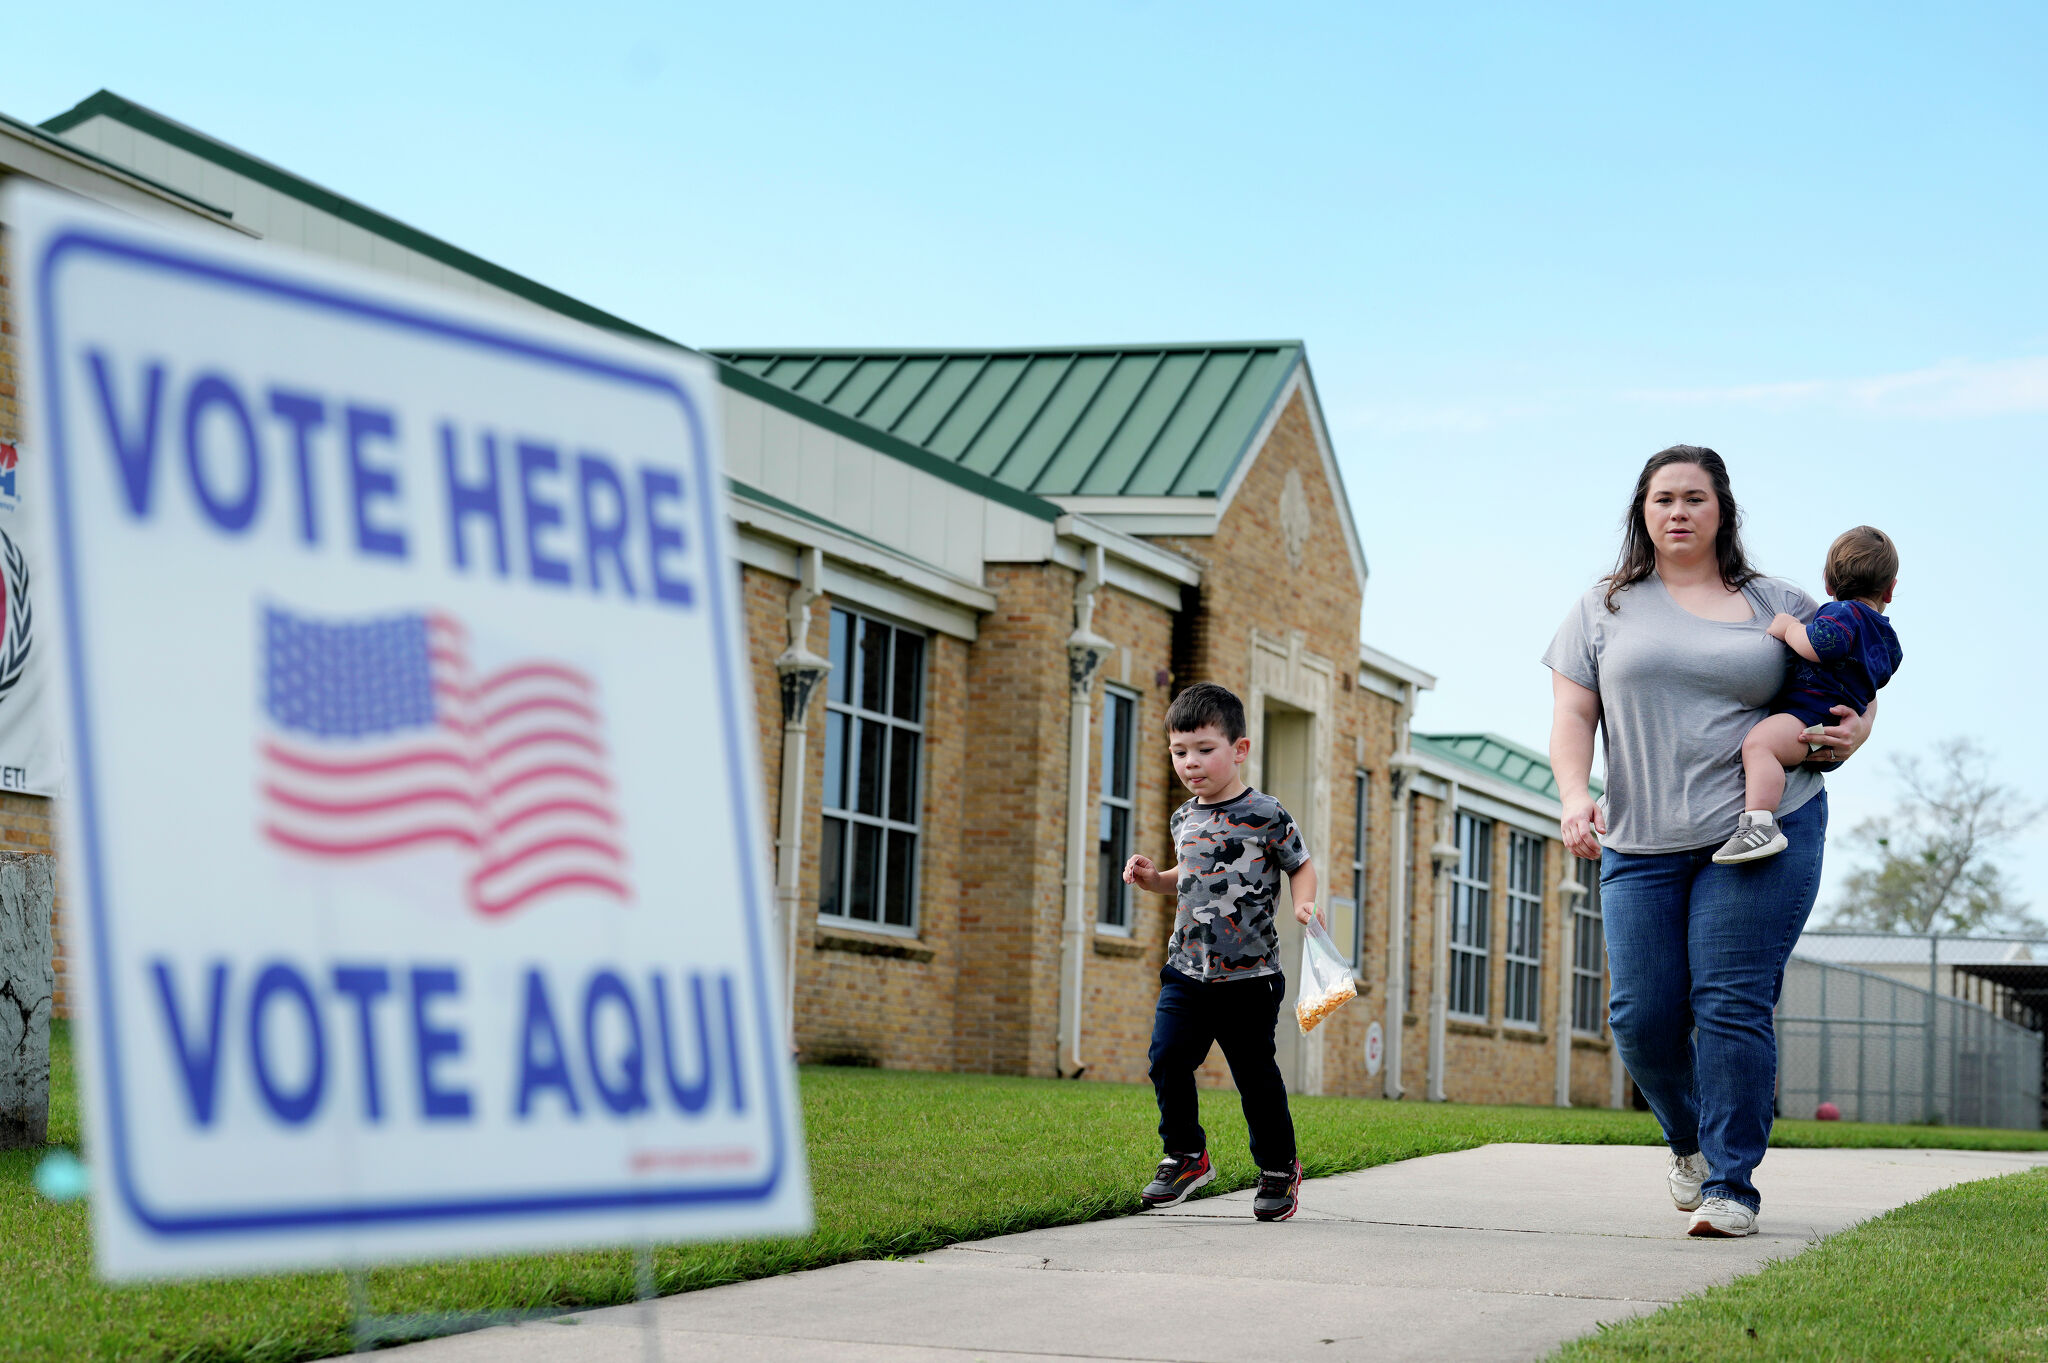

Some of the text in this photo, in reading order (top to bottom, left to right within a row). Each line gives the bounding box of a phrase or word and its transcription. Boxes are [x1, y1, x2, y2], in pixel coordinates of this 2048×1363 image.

[82, 344, 696, 609] VOTE HERE
[0, 765, 26, 789] ET!
[147, 957, 748, 1133] VOTE AQUI
